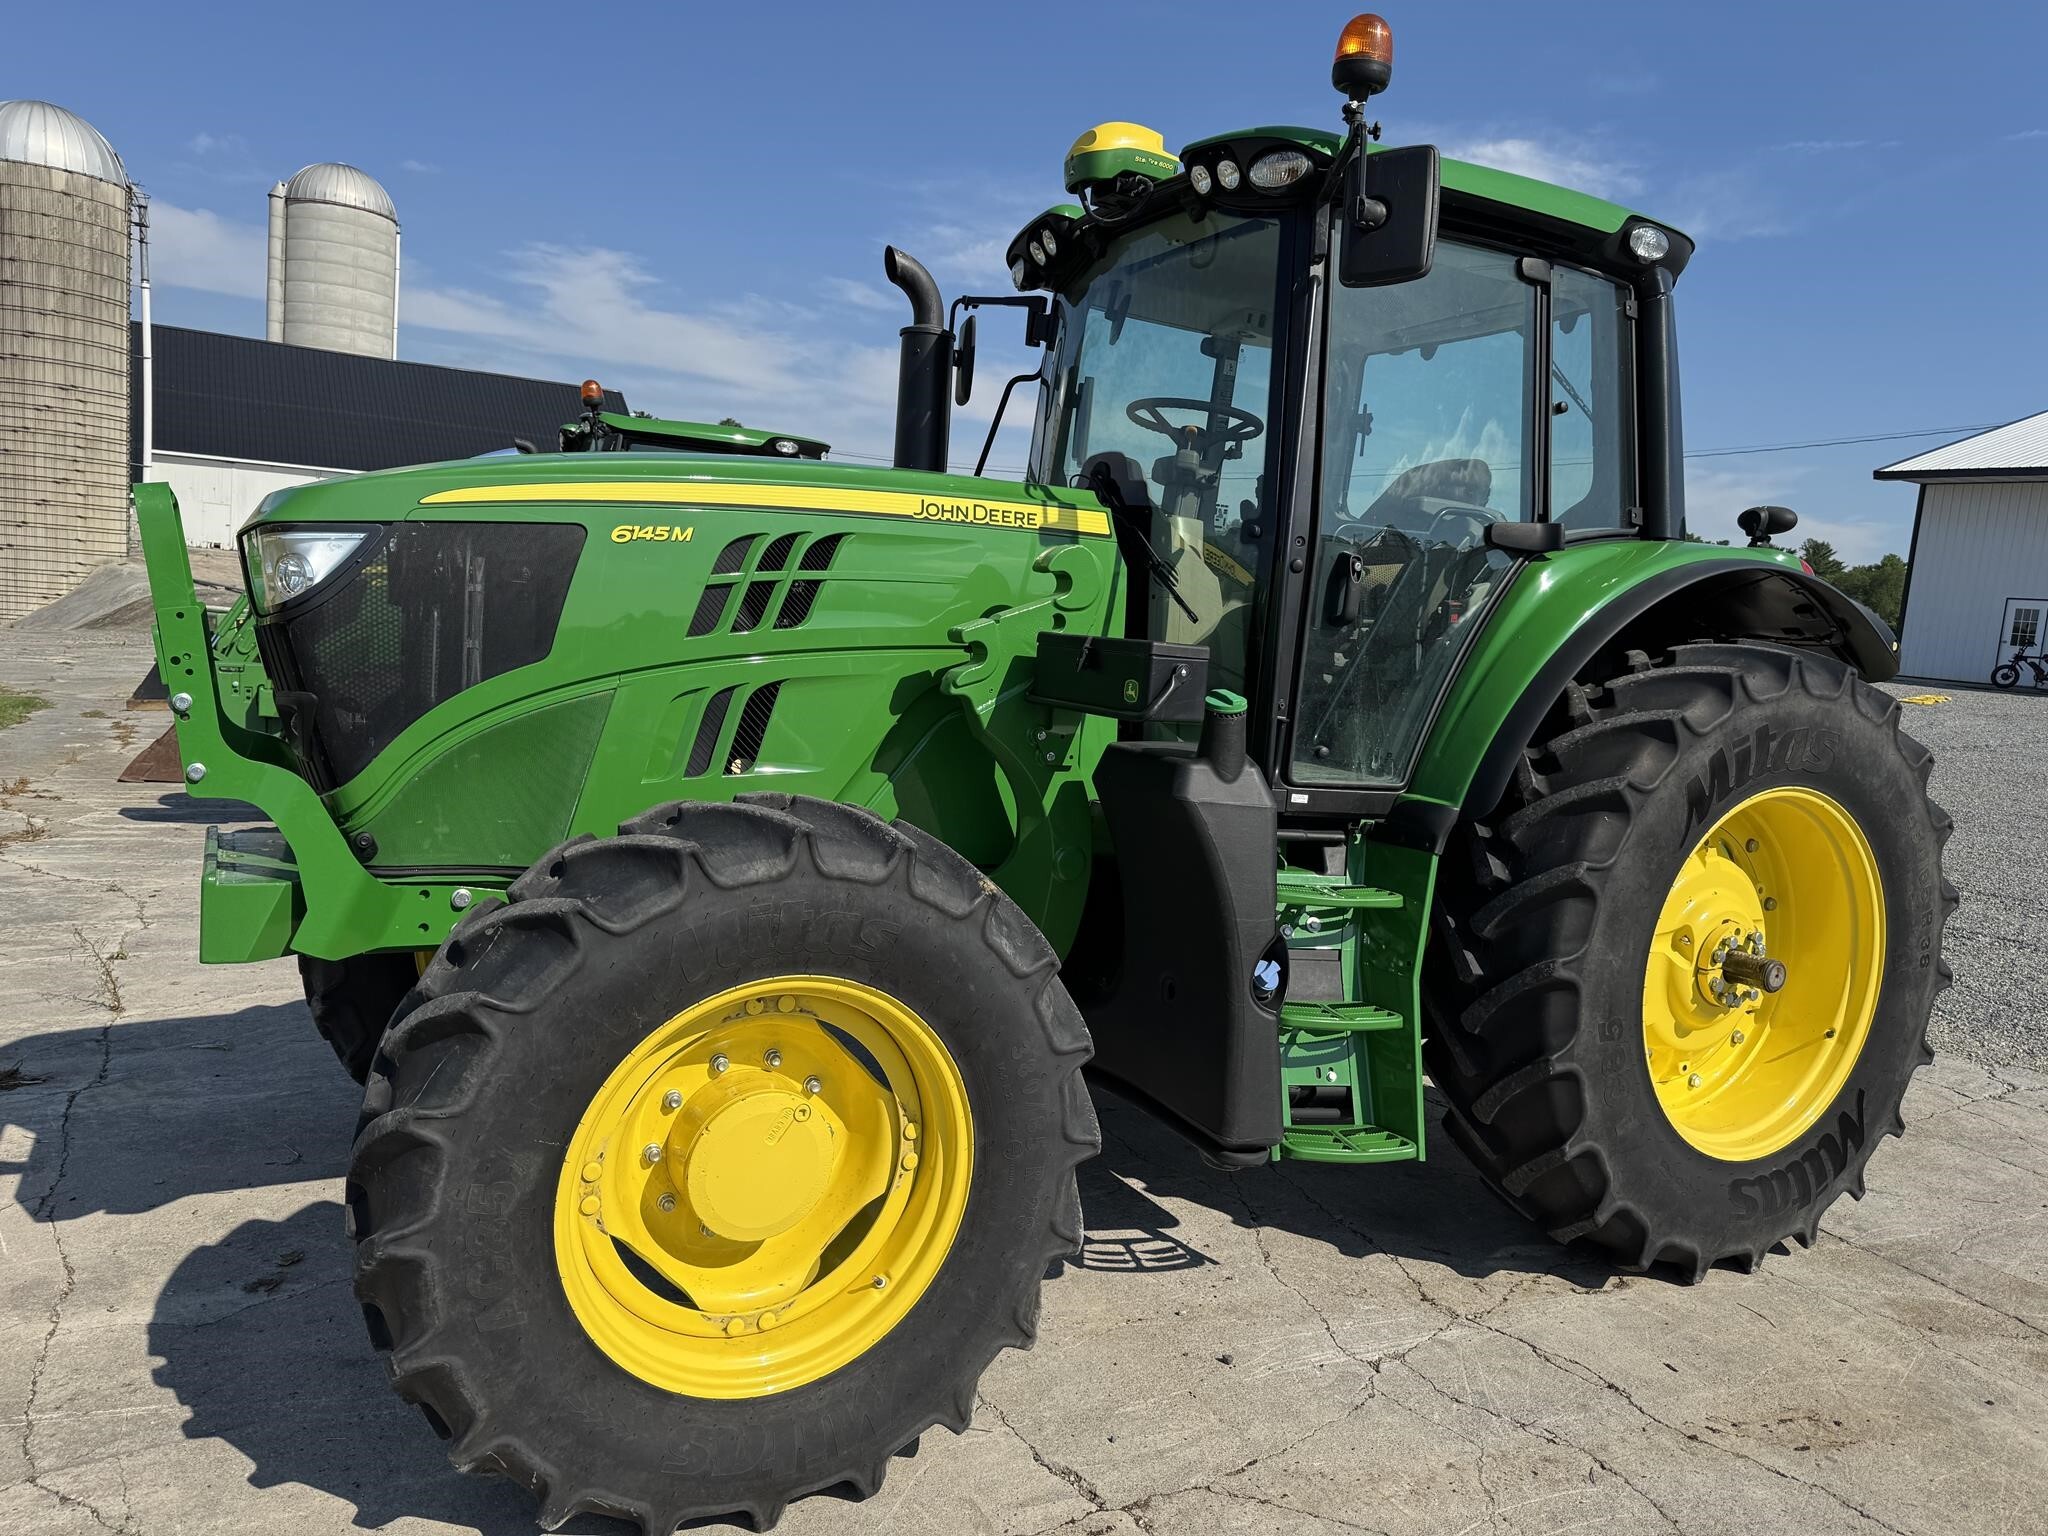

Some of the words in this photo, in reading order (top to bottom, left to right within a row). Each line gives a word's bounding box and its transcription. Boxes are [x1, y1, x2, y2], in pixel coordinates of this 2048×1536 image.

[610, 525, 695, 544] 6145M
[913, 498, 969, 520] JOHN
[973, 503, 1038, 527] DEERE
[1680, 723, 1841, 849] Mitas
[1727, 1087, 1866, 1223] Mitas
